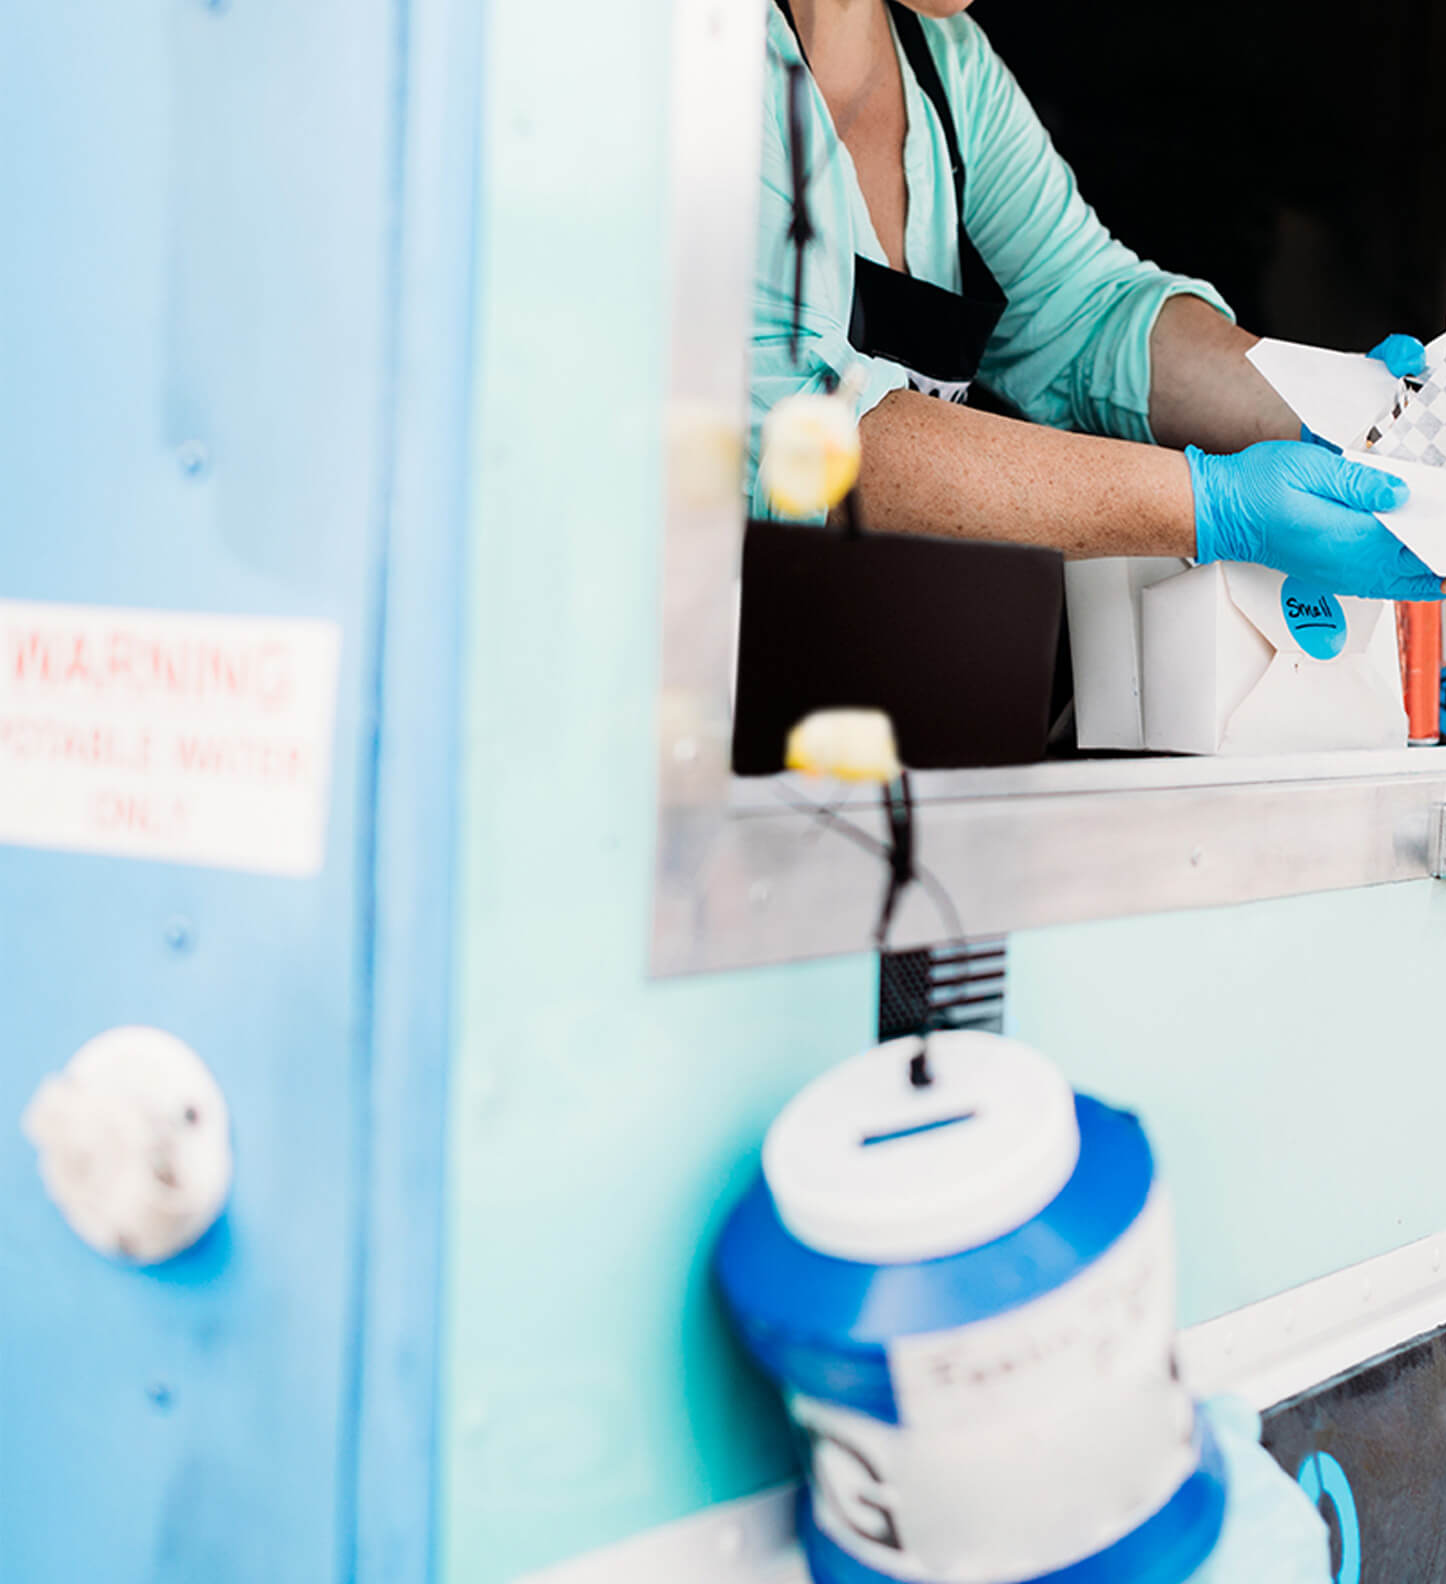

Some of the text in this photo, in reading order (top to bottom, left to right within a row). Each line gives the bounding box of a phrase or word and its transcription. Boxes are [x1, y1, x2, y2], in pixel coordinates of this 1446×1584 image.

[1286, 595, 1333, 618] Small
[11, 631, 295, 712] WARNING
[179, 736, 309, 785] WATER
[92, 793, 191, 838] ONLY
